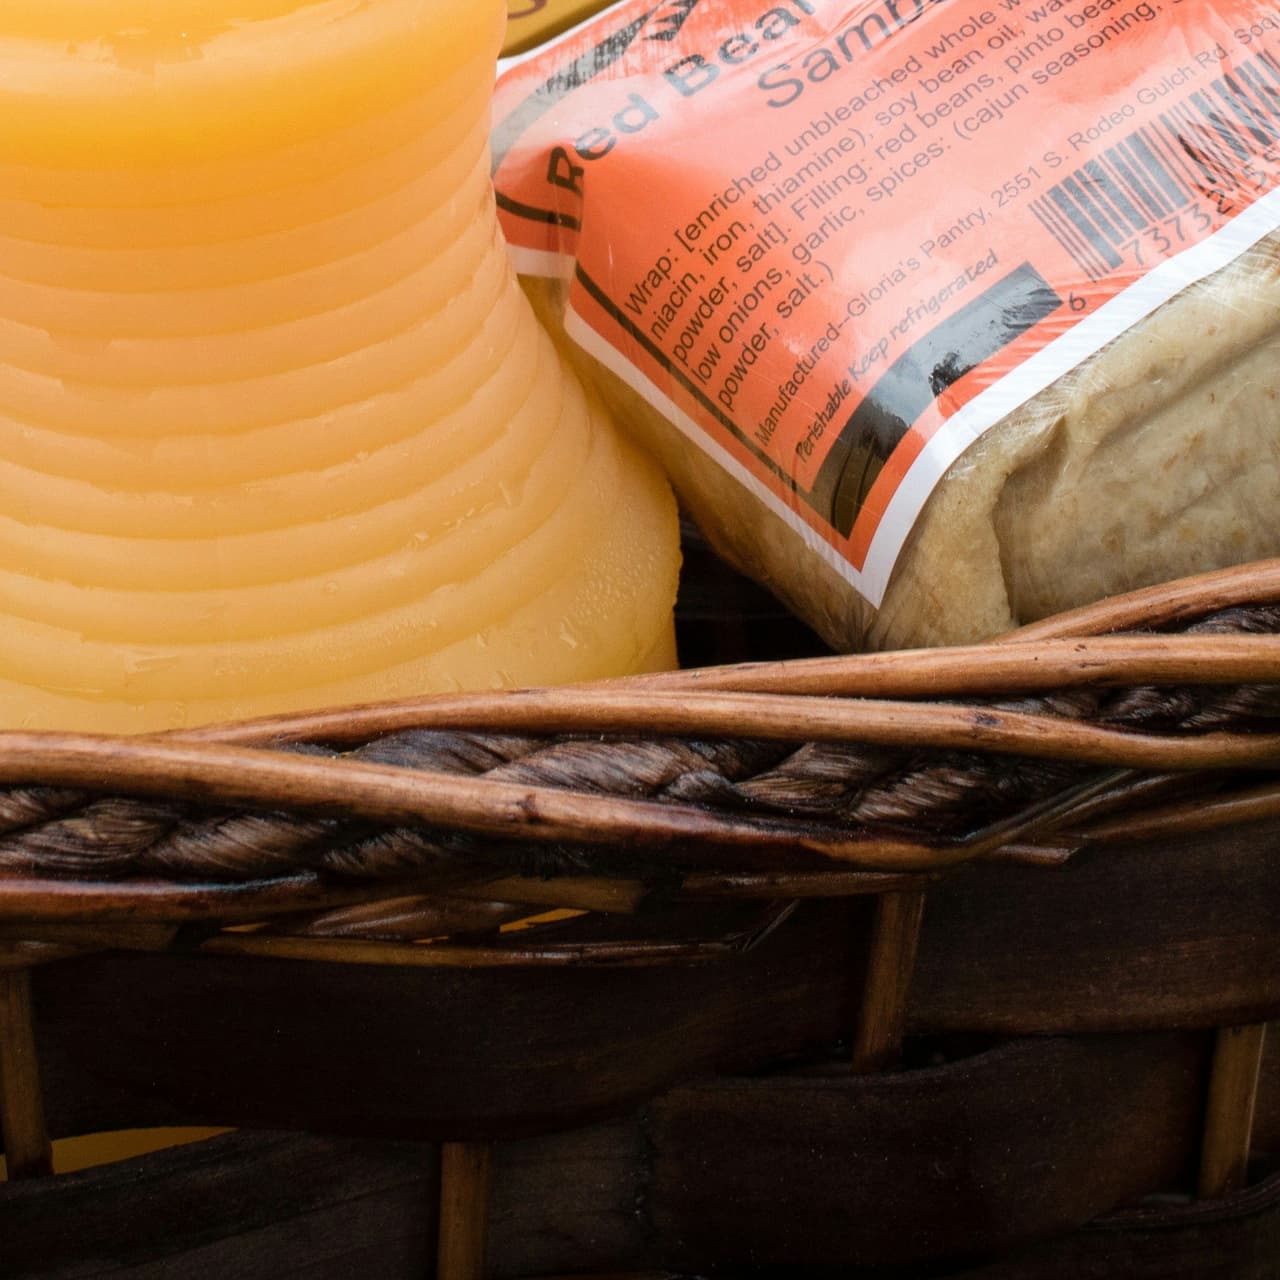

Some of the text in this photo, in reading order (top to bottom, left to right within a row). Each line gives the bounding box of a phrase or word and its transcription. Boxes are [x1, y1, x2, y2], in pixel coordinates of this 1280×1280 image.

[546, 92, 659, 194] Red
[624, 249, 679, 316] Wrap:
[674, 150, 782, 254] [enriched
[784, 55, 922, 157] unbleached
[924, 10, 997, 60] whole
[650, 270, 706, 341] niacin,
[698, 220, 755, 266] iron,
[752, 127, 874, 216] thiamine),
[874, 90, 918, 126] soy
[920, 49, 985, 94] bean
[987, 24, 1026, 50] oil,
[672, 277, 739, 367] powder,
[736, 221, 792, 274] salt].
[790, 157, 873, 221] Filling:
[875, 124, 917, 161] red
[917, 72, 1004, 129] beans,
[1004, 27, 1064, 75] pinto
[691, 342, 722, 386] low
[719, 266, 791, 344] onions,
[790, 204, 866, 265] garlic,
[865, 137, 951, 202] spices:
[952, 83, 1029, 141] (cajun
[1031, 1, 1162, 86] seasoning,
[920, 207, 994, 258] Pantry,
[990, 166, 1042, 208] 2551
[1042, 150, 1069, 169] S.
[1066, 103, 1135, 151] Rodeo
[1136, 63, 1197, 106] Gulch
[1193, 42, 1235, 70] Rd.
[717, 259, 835, 412] powder, salt.)
[794, 248, 999, 464] Perishable Keep refrigerated
[1069, 291, 1087, 312] 6
